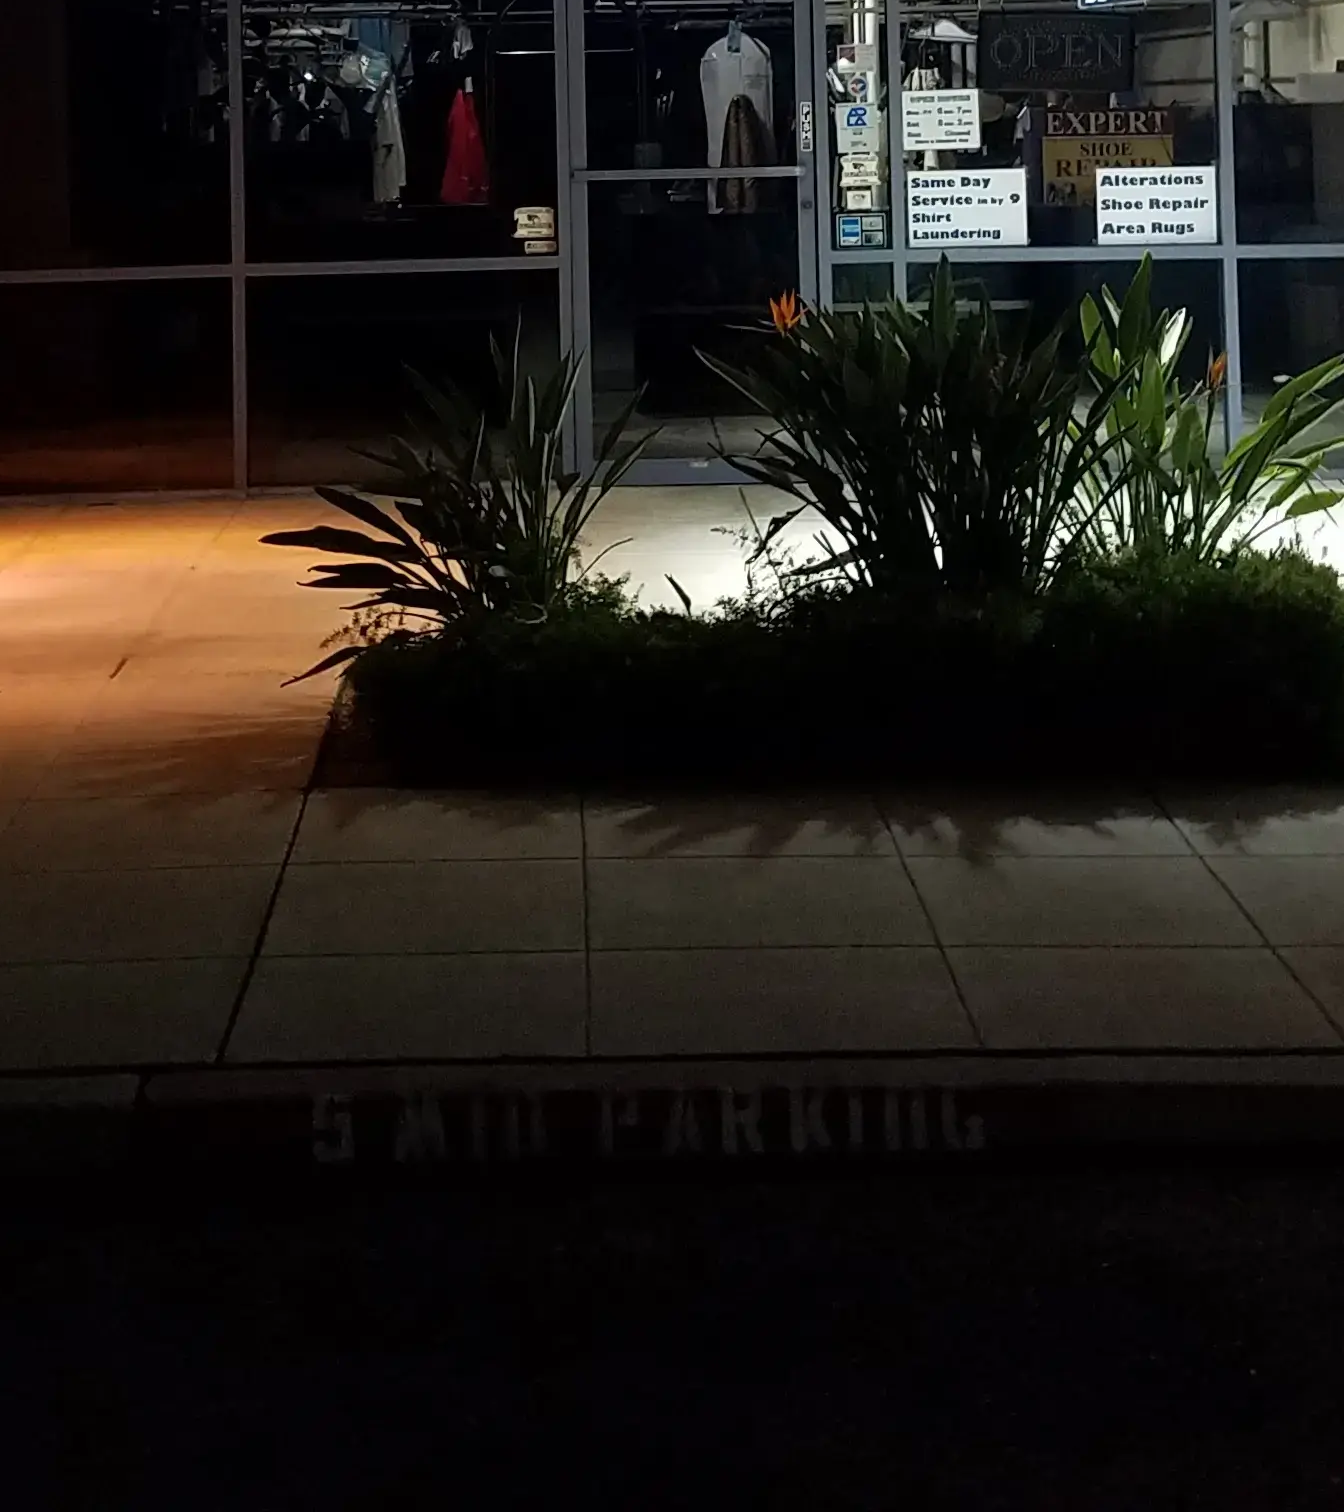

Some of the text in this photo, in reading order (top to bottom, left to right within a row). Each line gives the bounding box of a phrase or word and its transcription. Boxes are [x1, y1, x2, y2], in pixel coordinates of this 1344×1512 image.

[990, 32, 1126, 70] OPEN
[1046, 111, 1168, 135] EXPERT
[1080, 142, 1133, 157] SHOE
[911, 176, 991, 189] Same Day
[1100, 174, 1204, 186] Alterations
[911, 195, 973, 206] Service
[1009, 193, 1021, 204] 9
[1100, 198, 1209, 211] Shoe Repair
[912, 212, 952, 223] Shirt
[912, 228, 1001, 240] Laundering
[1101, 222, 1195, 235] Area Rugs
[311, 1087, 988, 1163] 5 MIN PARKING
